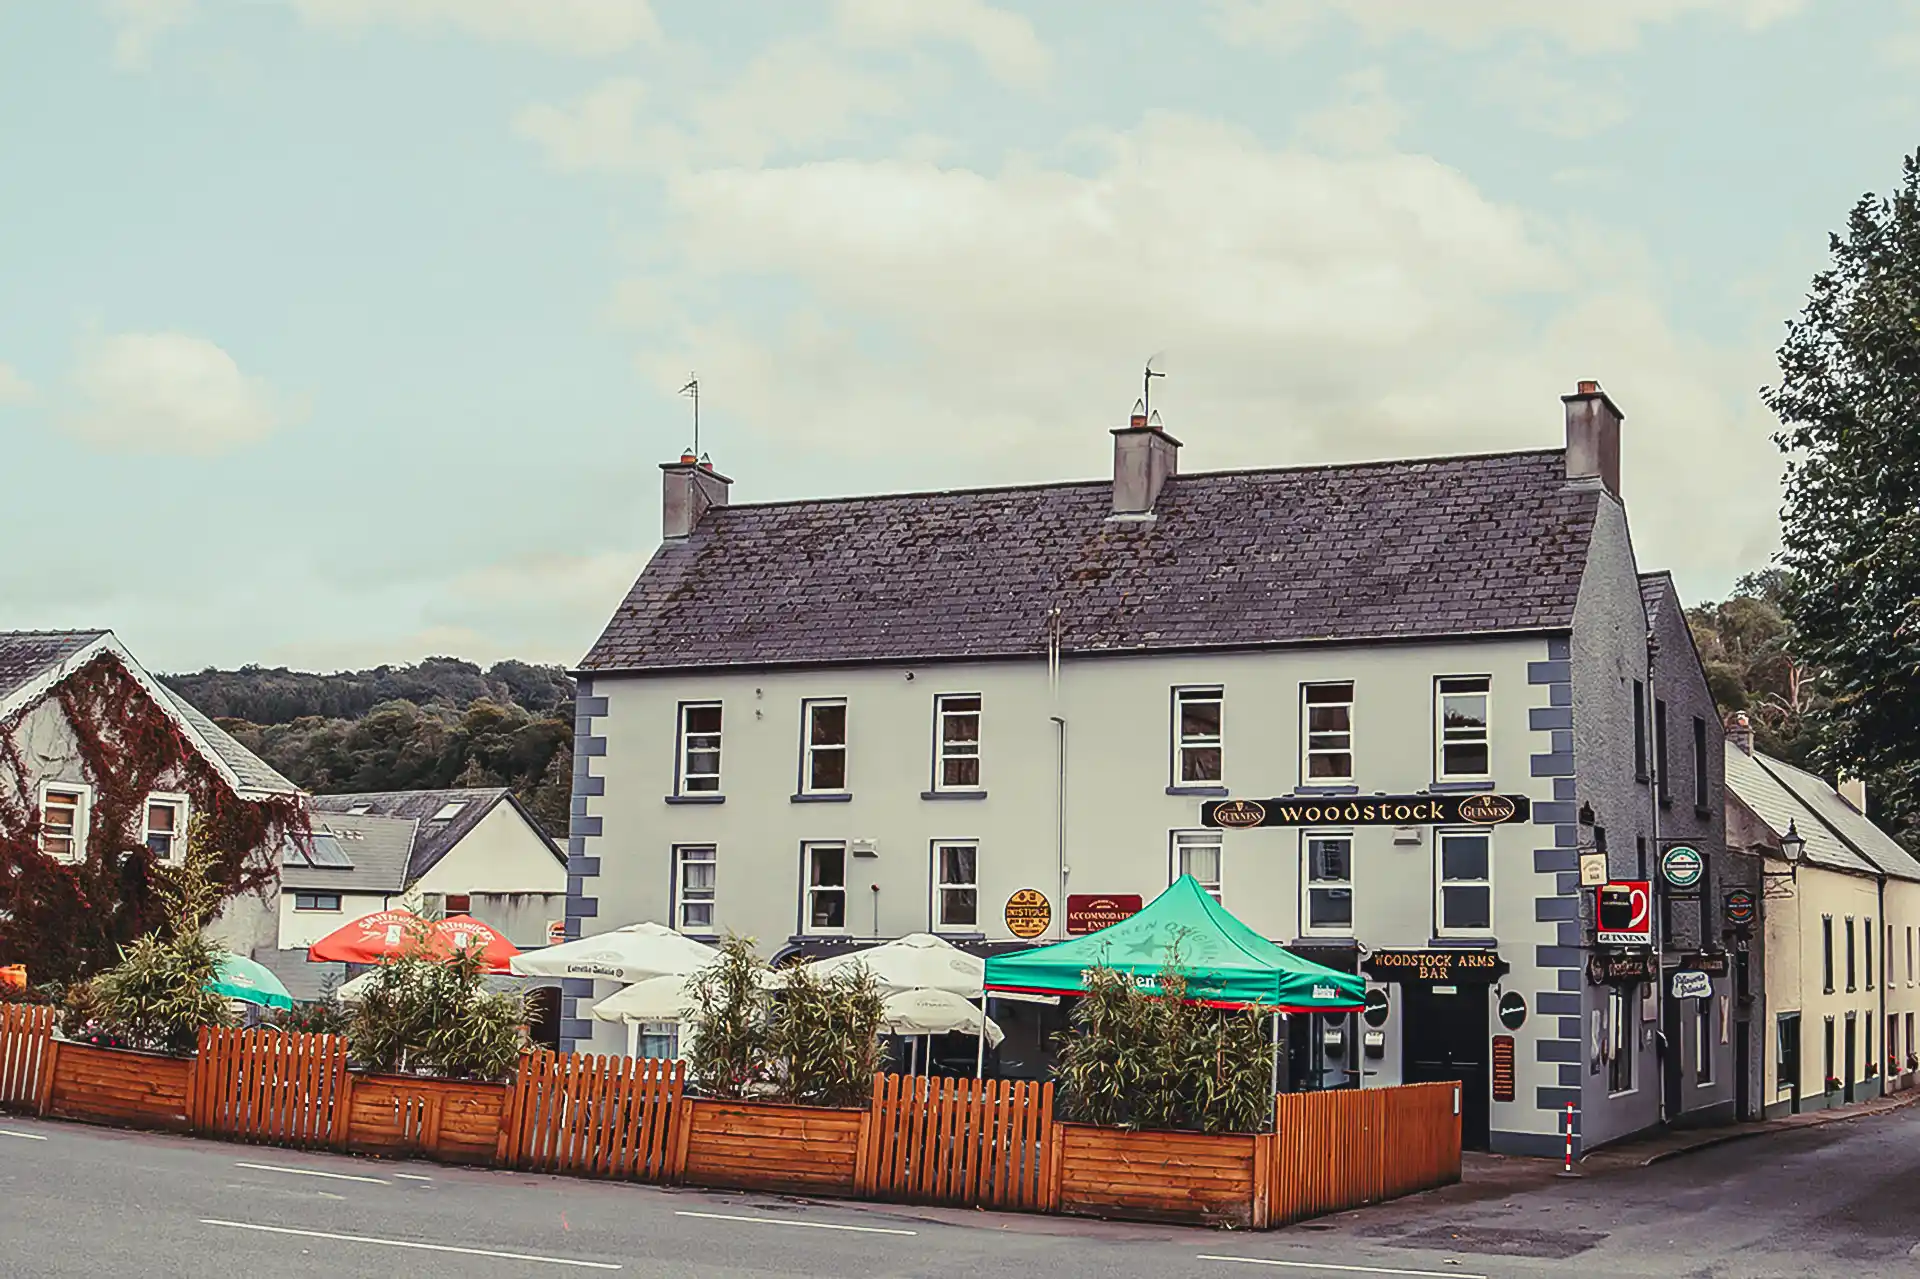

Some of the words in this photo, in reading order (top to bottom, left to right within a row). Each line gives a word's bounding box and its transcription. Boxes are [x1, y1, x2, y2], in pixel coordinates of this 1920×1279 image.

[1218, 810, 1262, 821] GUINNESS
[1463, 806, 1511, 817] GUINNESS
[1375, 954, 1452, 967] WOODSTOCK
[1458, 955, 1496, 967] ARMS
[1419, 966, 1449, 979] BAR
